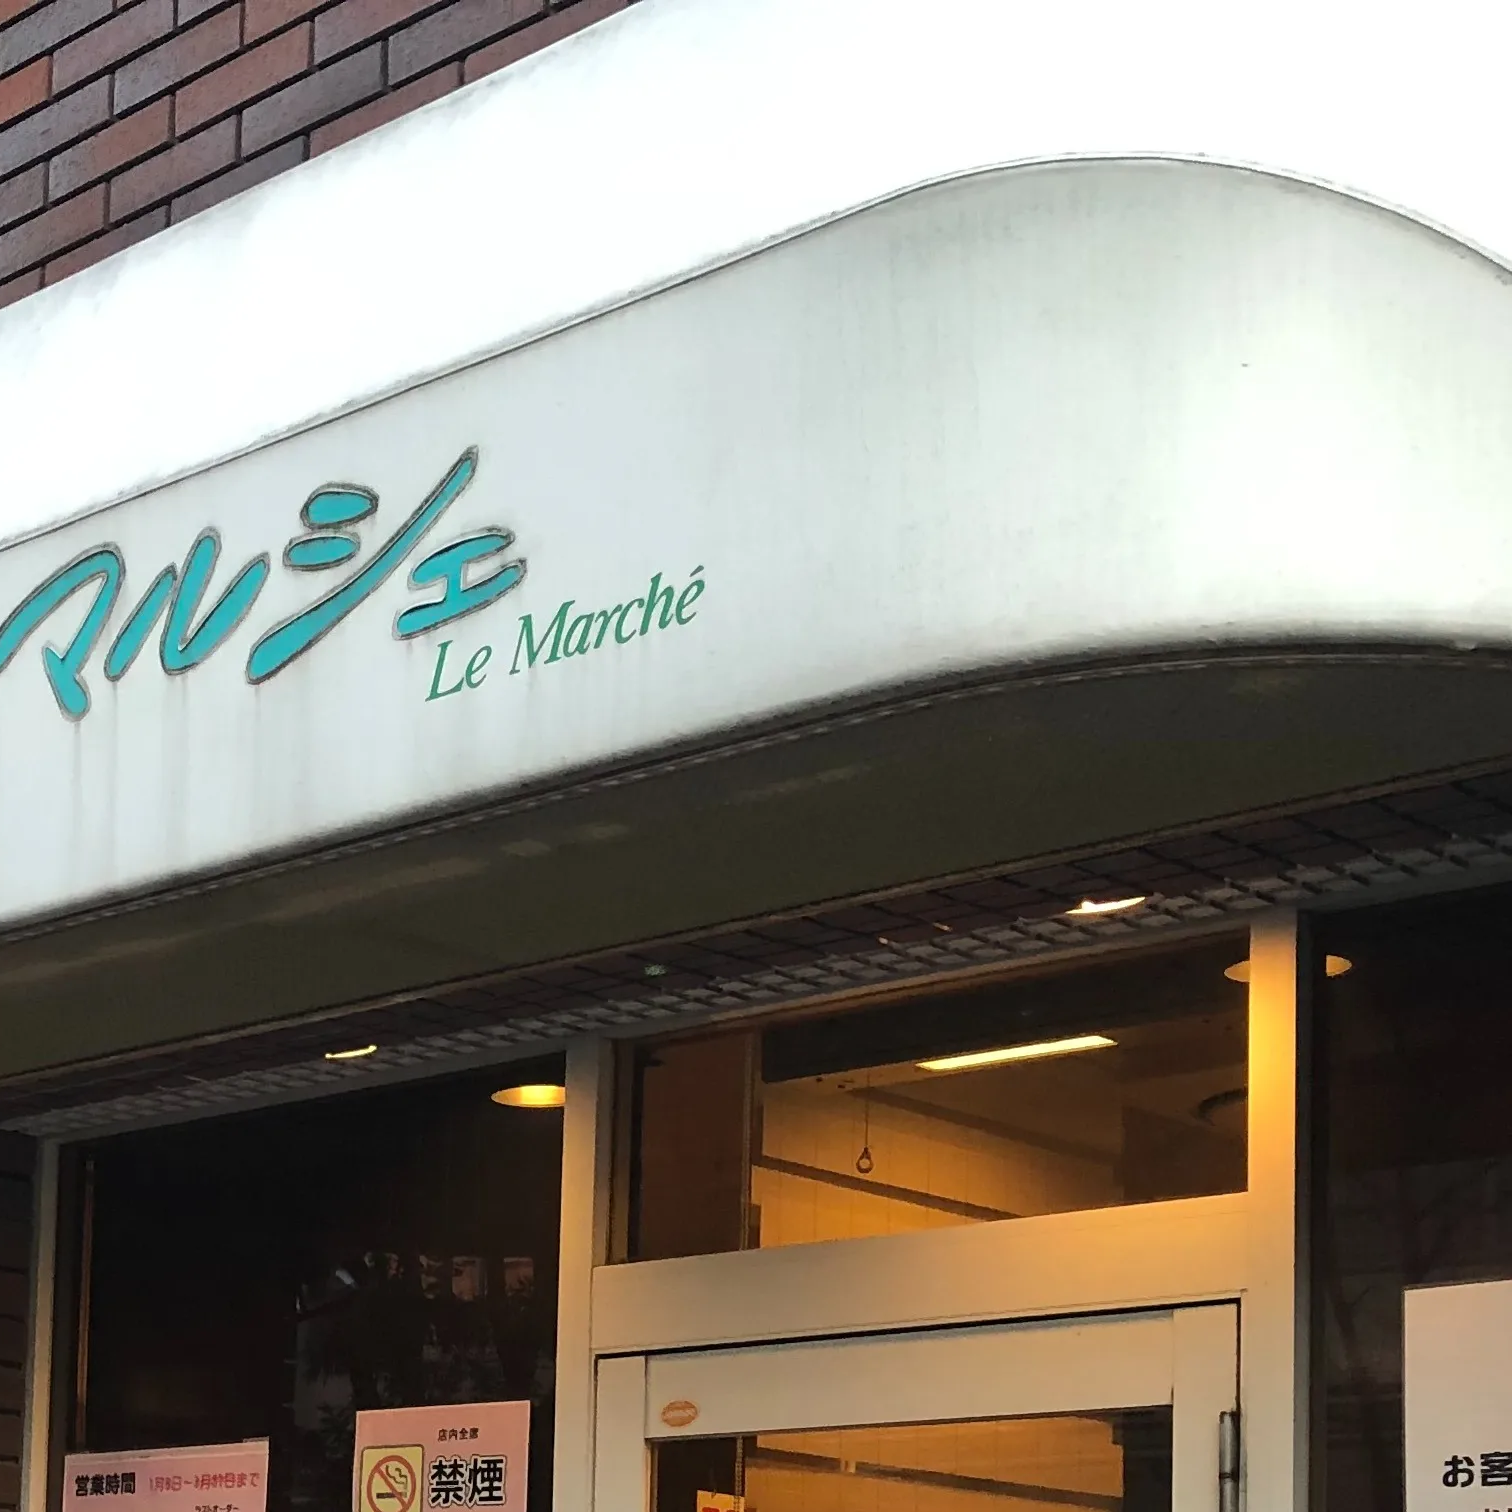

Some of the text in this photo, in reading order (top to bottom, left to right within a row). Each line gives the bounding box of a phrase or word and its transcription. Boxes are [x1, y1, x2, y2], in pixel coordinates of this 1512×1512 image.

[425, 564, 707, 702] Le Marché
[437, 1427, 479, 1441] 店内全席
[75, 1472, 136, 1496] 営業時間
[429, 1456, 506, 1507] 禁煙
